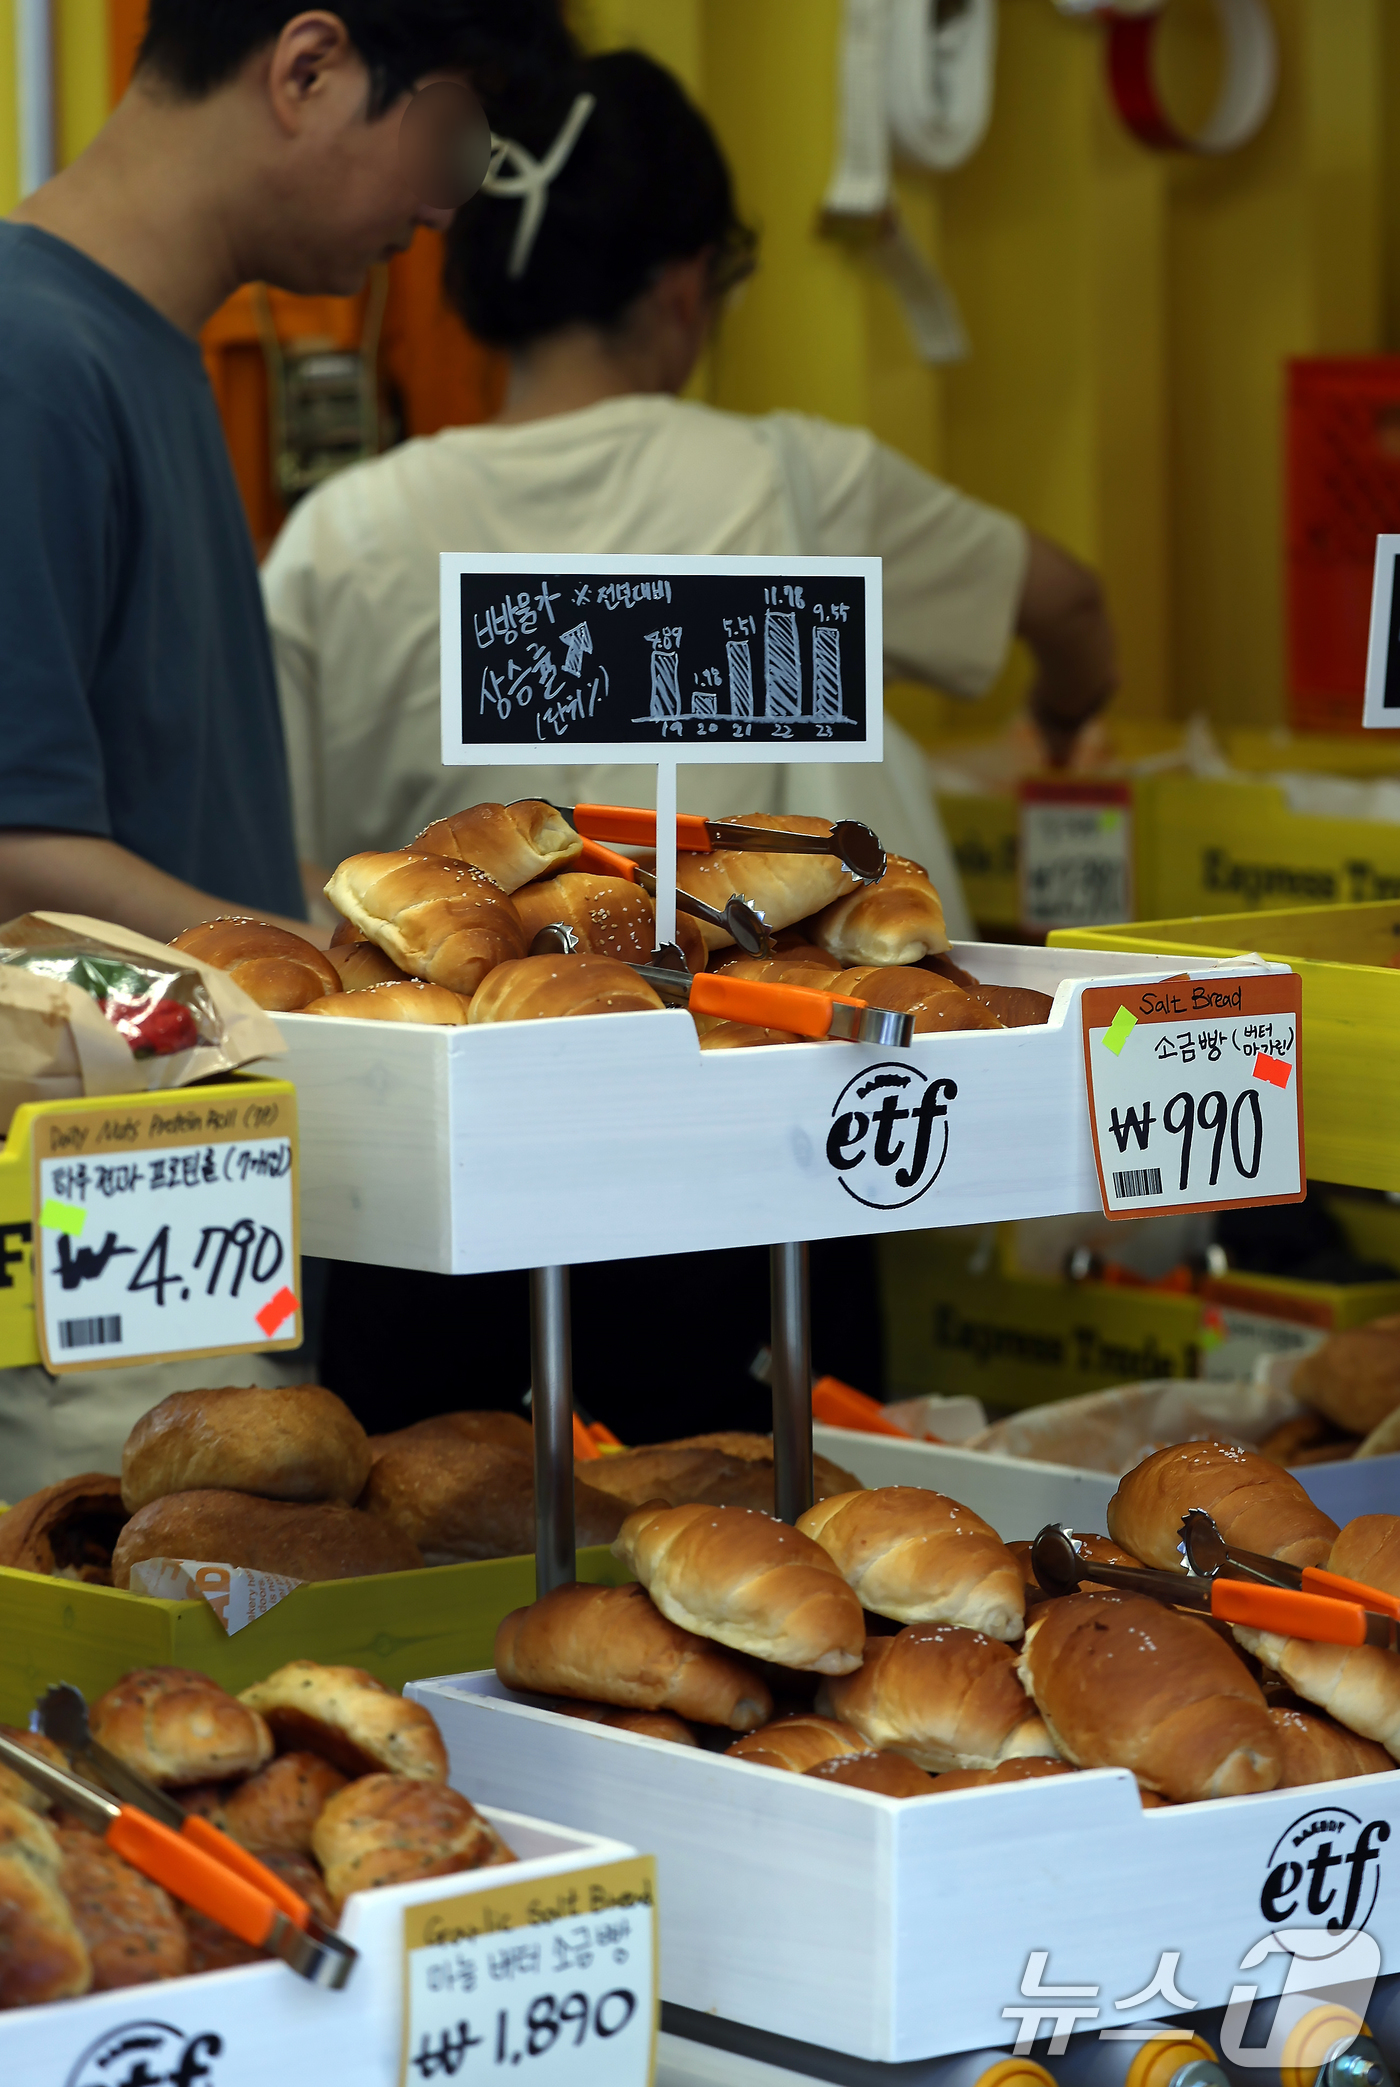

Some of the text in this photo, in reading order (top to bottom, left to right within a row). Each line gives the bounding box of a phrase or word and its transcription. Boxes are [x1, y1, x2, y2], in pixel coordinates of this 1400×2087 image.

[597, 579, 672, 613] 전년대비
[764, 585, 806, 610] 11.78
[722, 615, 757, 639] 5.51
[813, 603, 850, 624] 9.55
[643, 625, 684, 651] 4.89
[693, 667, 723, 688] 1.98
[662, 722, 834, 738] 19 20 21 22 23
[1139, 985, 1242, 1015] Salt Bread
[1154, 1029, 1228, 1064] 소금빵
[149, 1109, 202, 1139] Protein
[205, 1107, 237, 1132] Roll
[826, 1078, 958, 1187] etf
[51, 1163, 92, 1201] 하루
[95, 1162, 145, 1198] 견과
[1260, 1820, 1391, 1936] etf
[525, 1887, 578, 1925] Salt
[588, 1877, 654, 1913] Bread
[426, 1917, 632, 1994] 마늘 버터 소금빵
